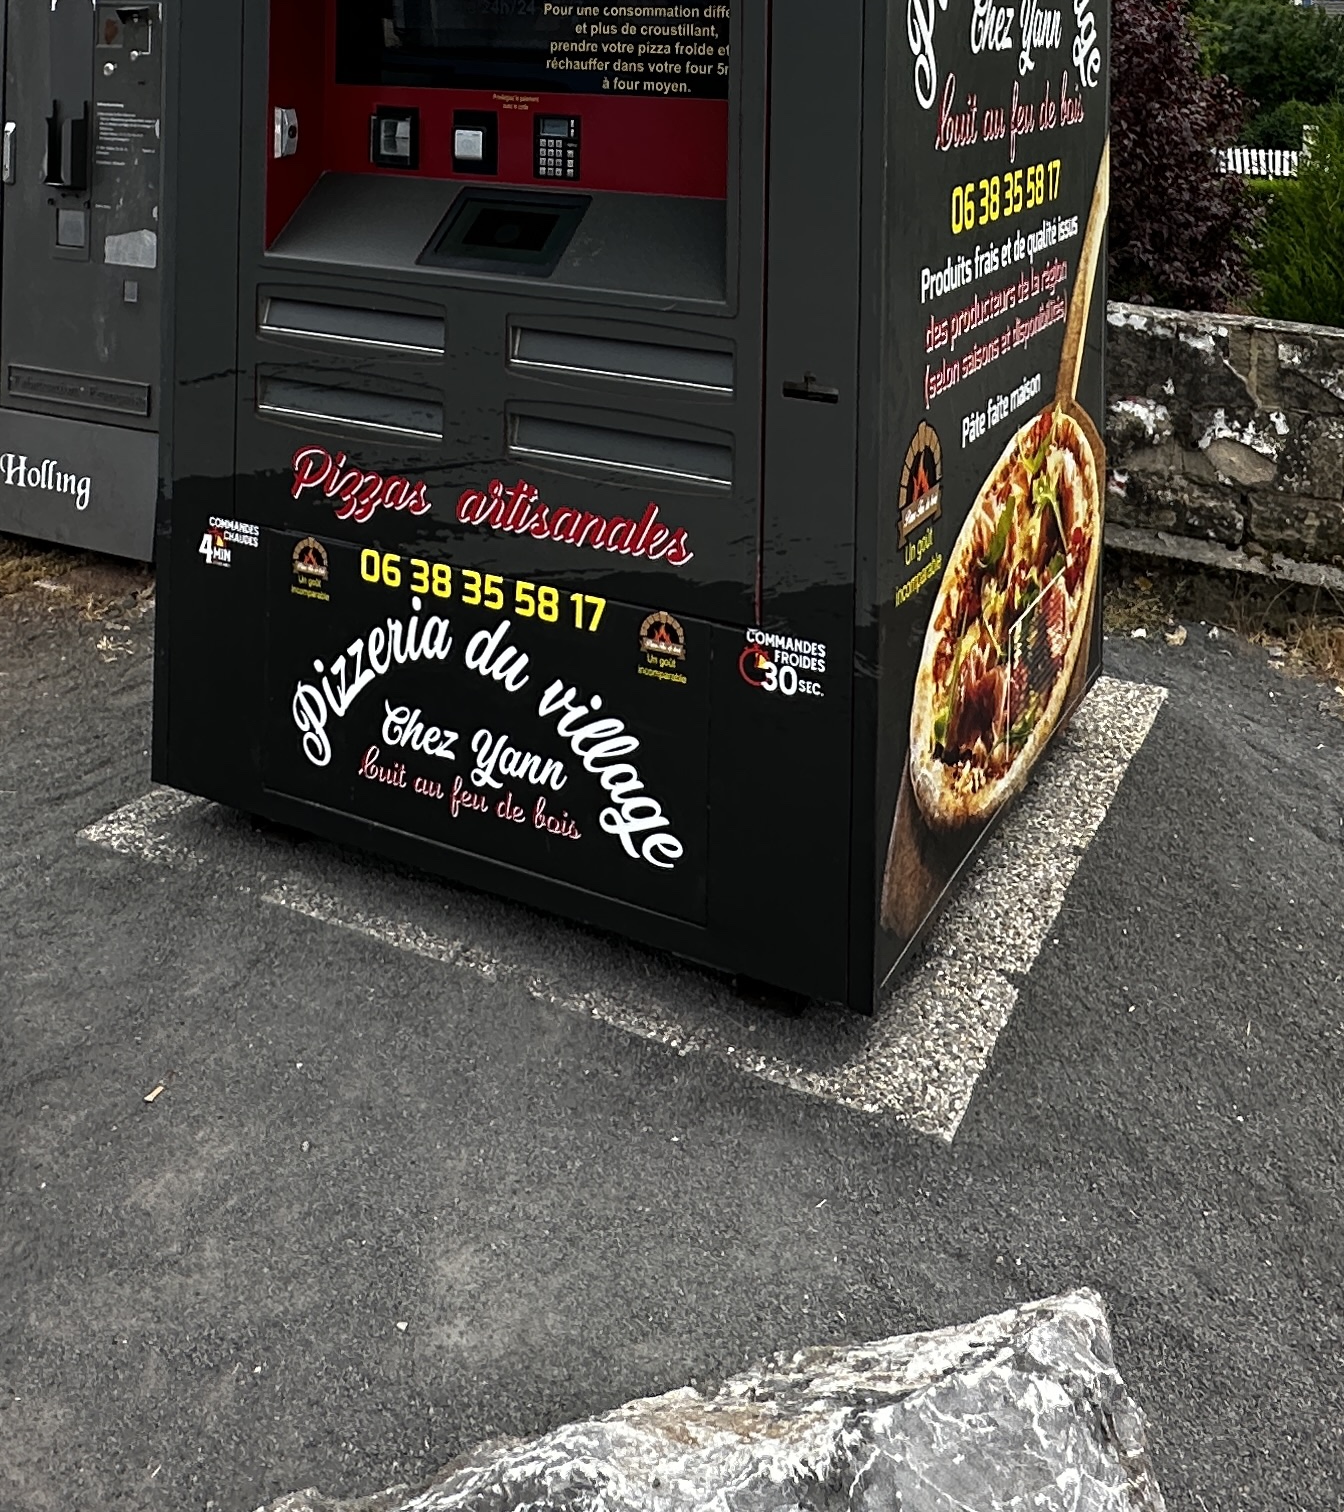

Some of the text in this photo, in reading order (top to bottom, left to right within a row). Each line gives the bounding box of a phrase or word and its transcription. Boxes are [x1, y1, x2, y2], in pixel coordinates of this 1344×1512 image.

[543, 3, 573, 16] Pour
[576, 6, 599, 16] une
[603, 4, 700, 18] consommation
[575, 22, 719, 39] et plus de croustillant,
[546, 57, 610, 71] réchauffer
[612, 59, 645, 73] dans
[648, 62, 682, 74] votre
[685, 63, 713, 75] four
[550, 40, 598, 54] prendre
[601, 41, 635, 54] votre
[638, 41, 671, 56] pizza
[675, 42, 714, 56] froide
[602, 76, 692, 95] à four moyen.
[982, 107, 1006, 141] au
[1010, 80, 1035, 164] feu
[1039, 80, 1056, 131] de
[1060, 70, 1084, 127] bois
[951, 159, 1061, 235] 06 38 35 58 17
[920, 256, 972, 304] Produits
[974, 242, 1000, 279] frais
[1001, 237, 1012, 267] et
[1013, 229, 1025, 261] de
[1027, 217, 1056, 264] qualité
[926, 257, 1068, 352] des producteurs de la région
[925, 358, 960, 410] (selon
[962, 338, 1000, 379] saisons
[1001, 325, 1011, 354] et
[962, 373, 1041, 449] Pâte faite maison
[0, 453, 92, 510] Holling
[290, 444, 694, 566] Pizzas artisanales
[199, 533, 231, 563] 4 MIN
[904, 543, 916, 566] Un
[361, 548, 402, 589] 06
[411, 558, 451, 599] 38
[461, 568, 504, 611] 35
[514, 581, 559, 623] 58
[571, 592, 606, 632] 17
[746, 630, 826, 658] COMMANDES
[774, 650, 826, 673] FROIDES
[761, 661, 825, 697] 30 SEC.
[293, 597, 683, 868] Pizzeria du village
[381, 698, 568, 791] Chez Yann
[413, 769, 444, 797] au
[450, 775, 489, 816] feu
[496, 792, 525, 823] de
[533, 796, 582, 840] bois
